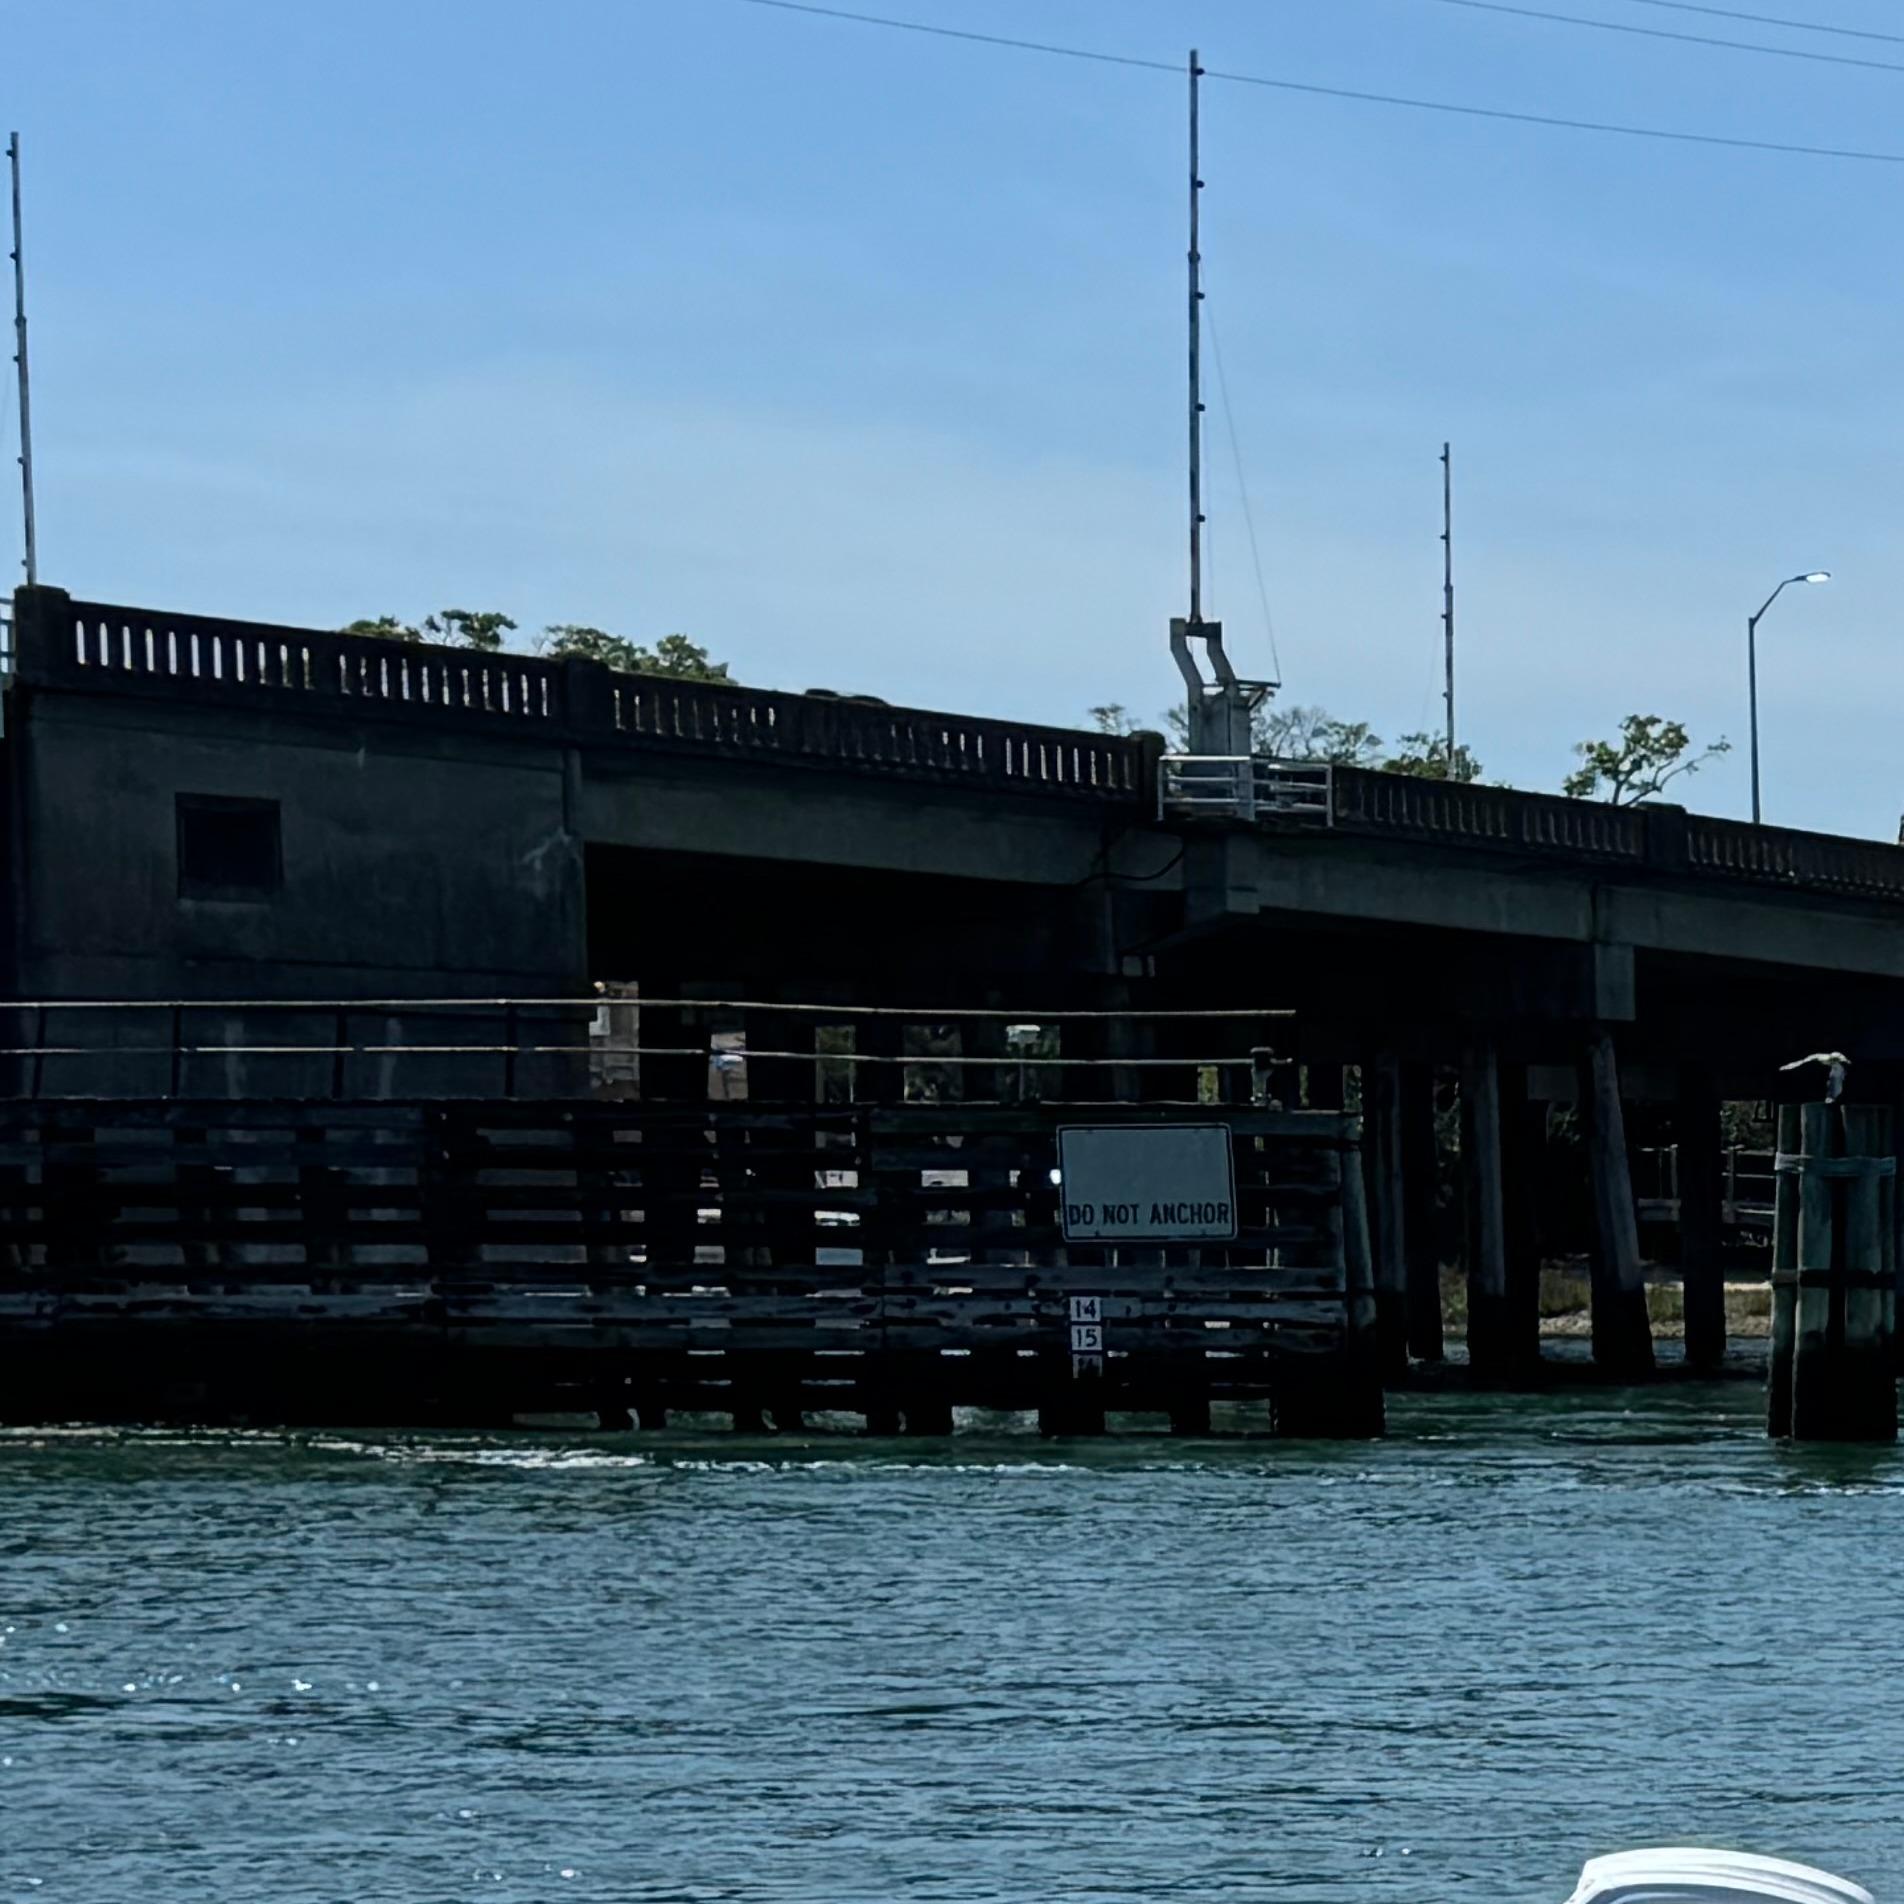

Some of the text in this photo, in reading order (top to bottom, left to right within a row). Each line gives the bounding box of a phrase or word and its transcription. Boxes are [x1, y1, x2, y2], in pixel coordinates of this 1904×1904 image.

[1068, 1202, 1230, 1226] DO NOT ANCHOR
[1076, 1299, 1096, 1319] 14
[1077, 1328, 1098, 1348] 15
